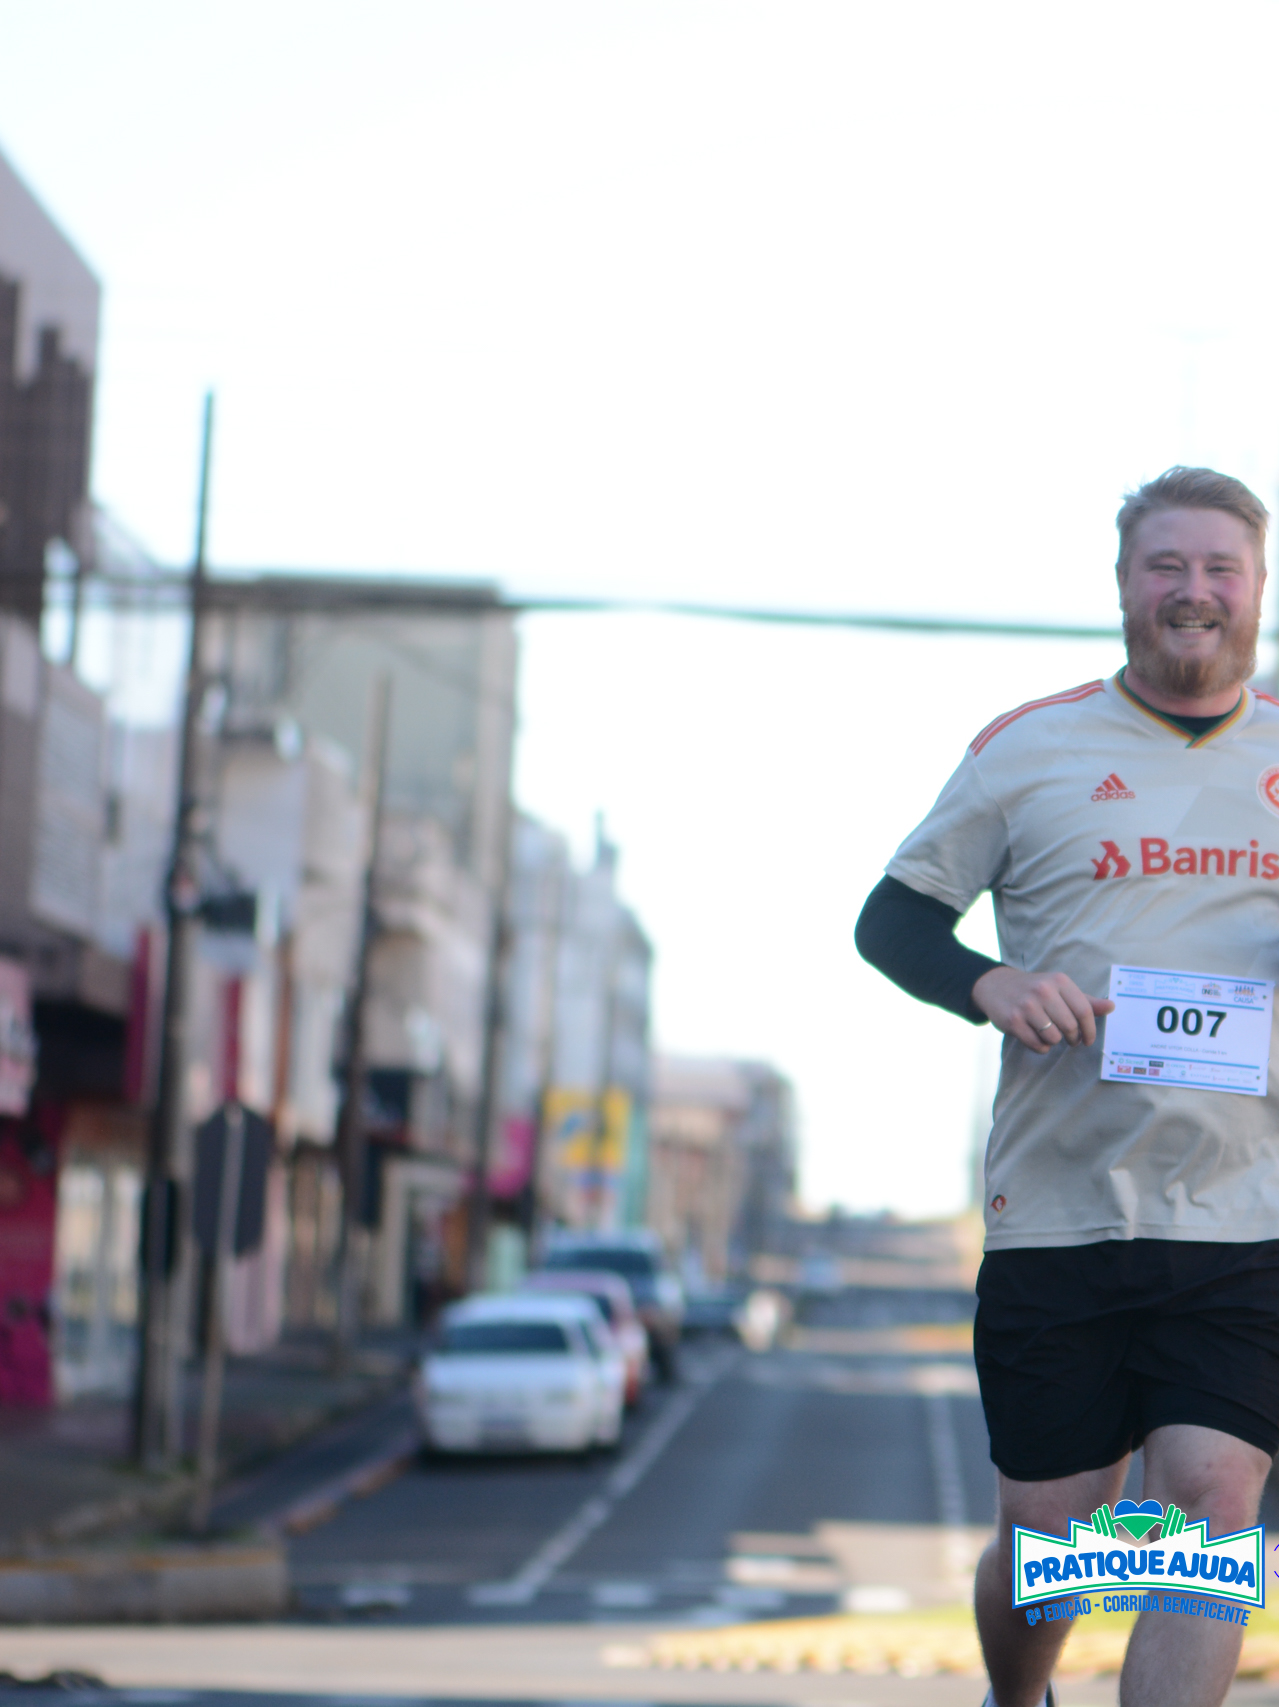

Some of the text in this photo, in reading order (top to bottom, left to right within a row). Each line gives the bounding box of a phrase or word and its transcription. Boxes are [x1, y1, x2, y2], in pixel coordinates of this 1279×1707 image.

[1091, 790, 1136, 802] adidas
[1233, 996, 1254, 1004] CAUSA
[1157, 1005, 1227, 1038] 007
